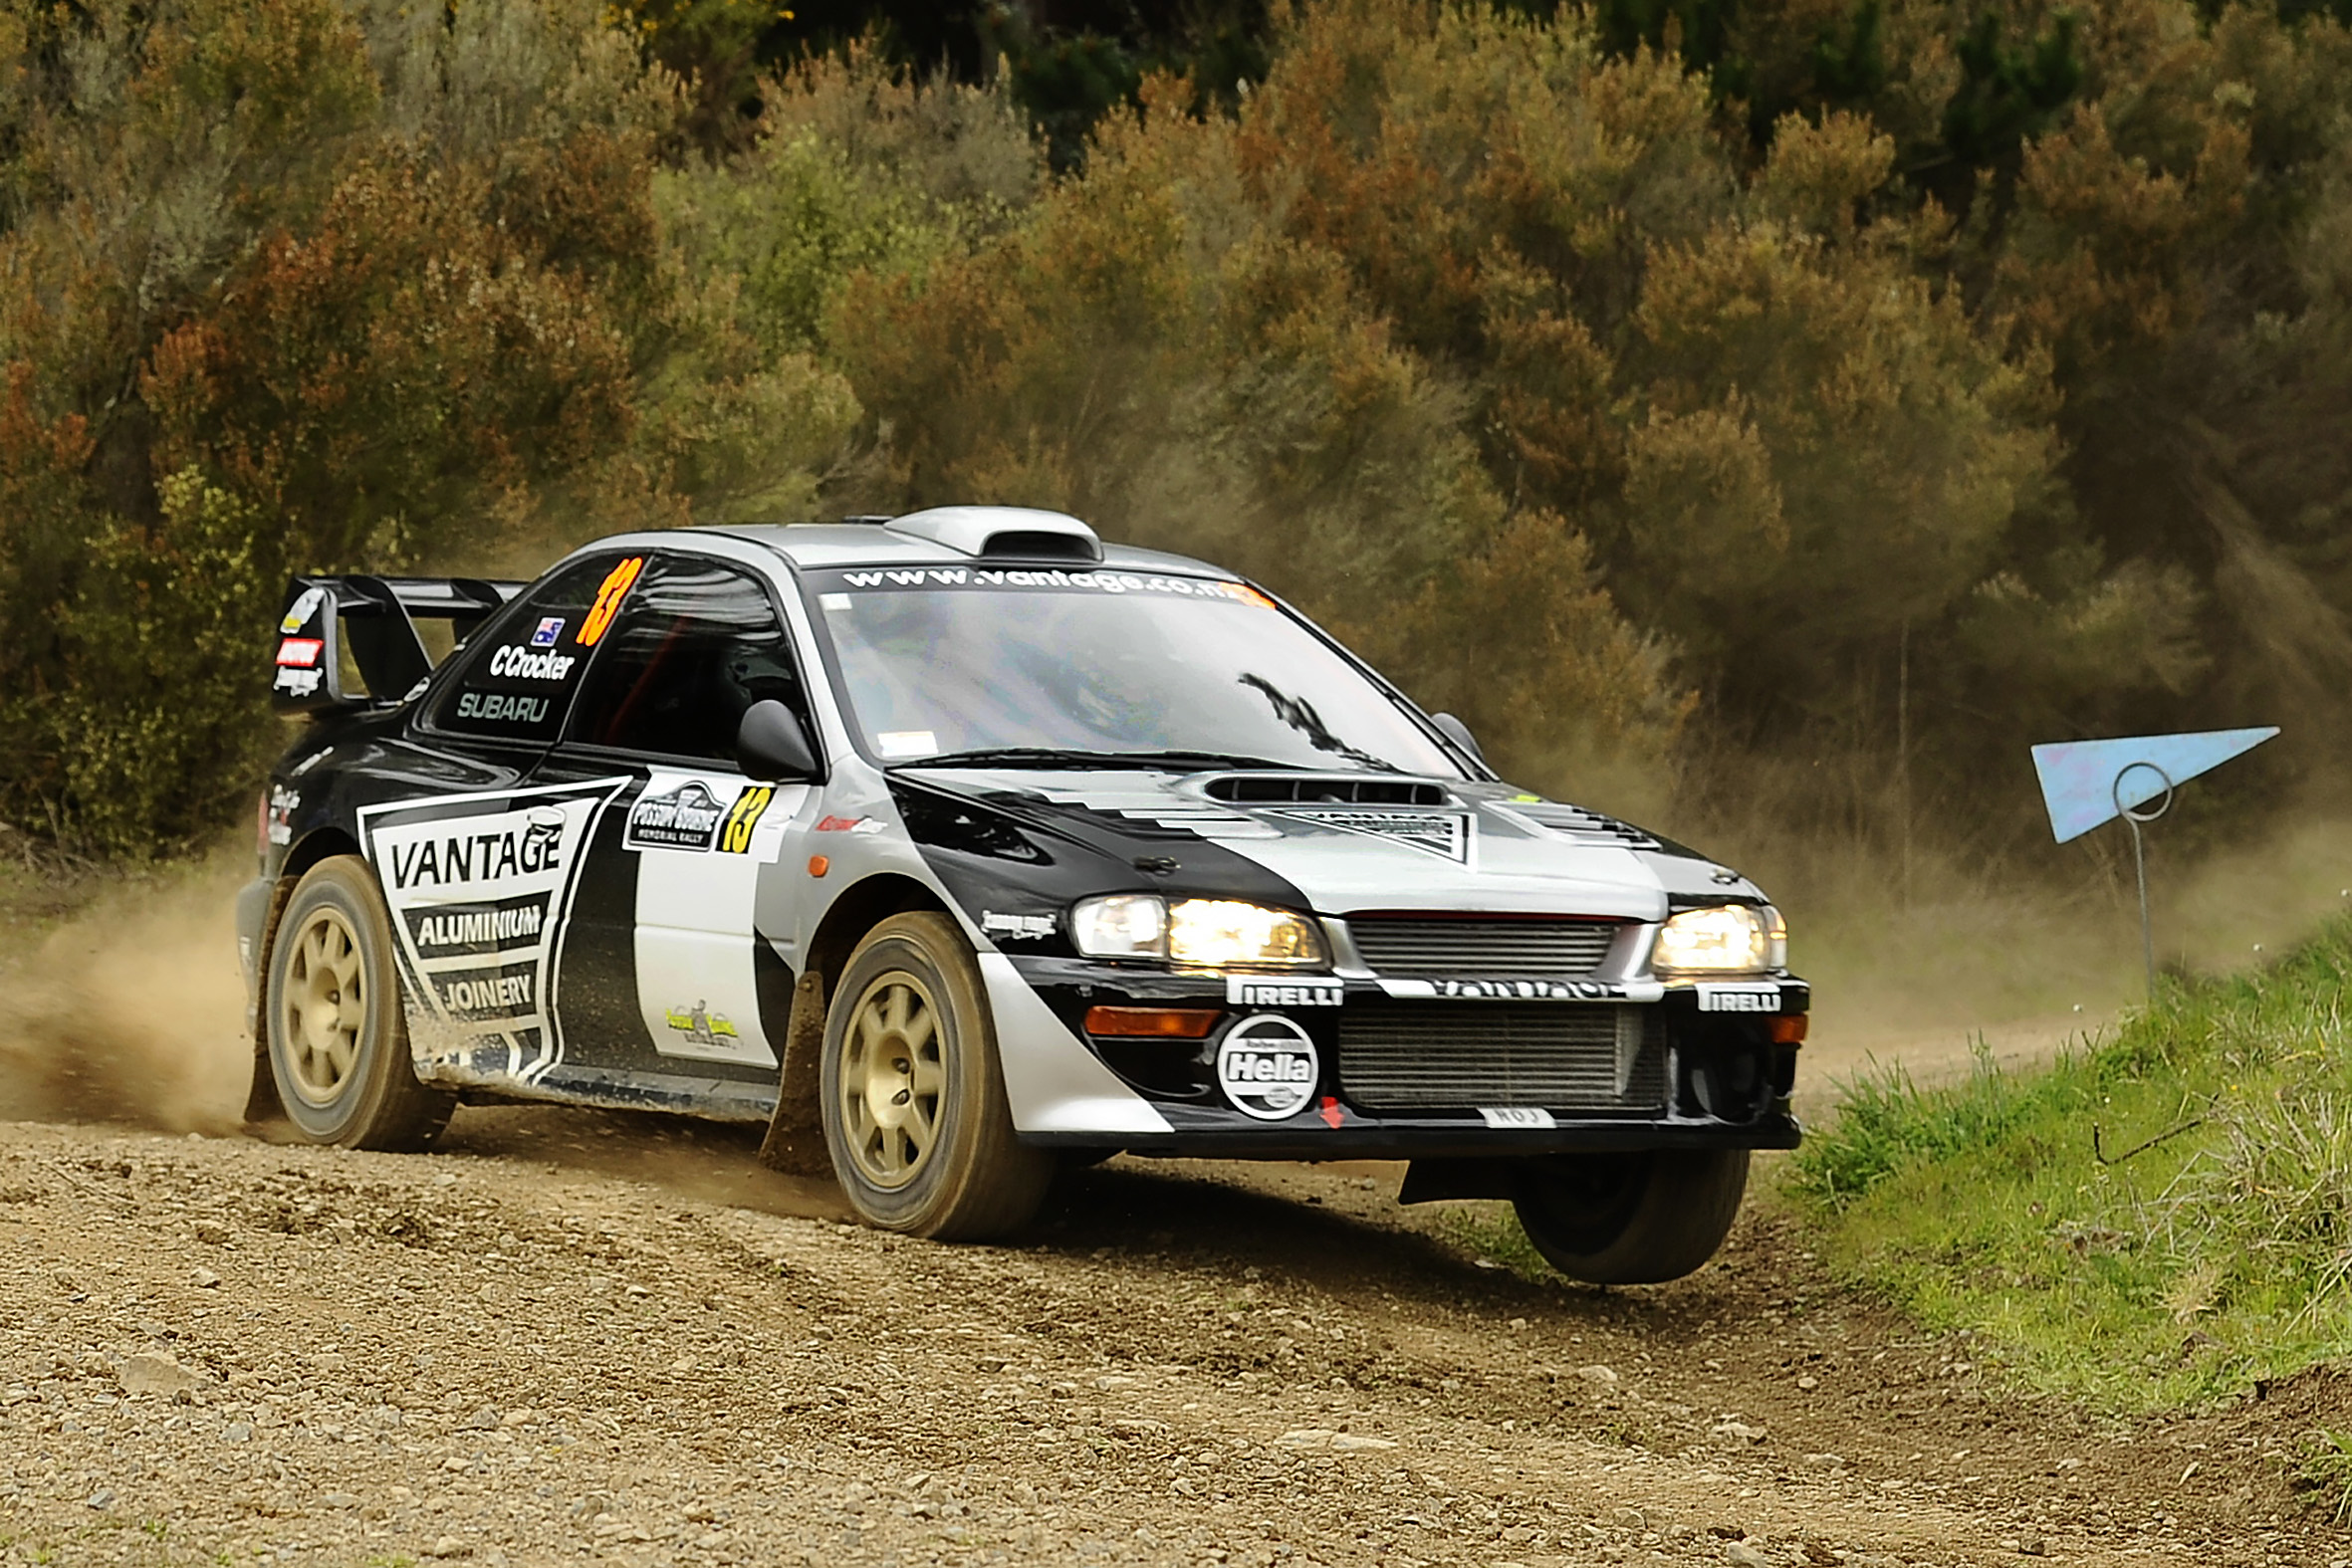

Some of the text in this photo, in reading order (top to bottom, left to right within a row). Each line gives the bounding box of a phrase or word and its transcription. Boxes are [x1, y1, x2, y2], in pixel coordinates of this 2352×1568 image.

[576, 557, 642, 646] 13
[457, 693, 549, 723] SUBARU
[722, 786, 771, 853] 13
[390, 825, 562, 889] VANTAGE
[417, 904, 541, 946] ALUMINIUM
[445, 974, 531, 1011] JOINERY
[1226, 977, 1344, 1006] PIRELLI
[1695, 982, 1781, 1011] PIRELLI
[1227, 1052, 1311, 1082] Hella
